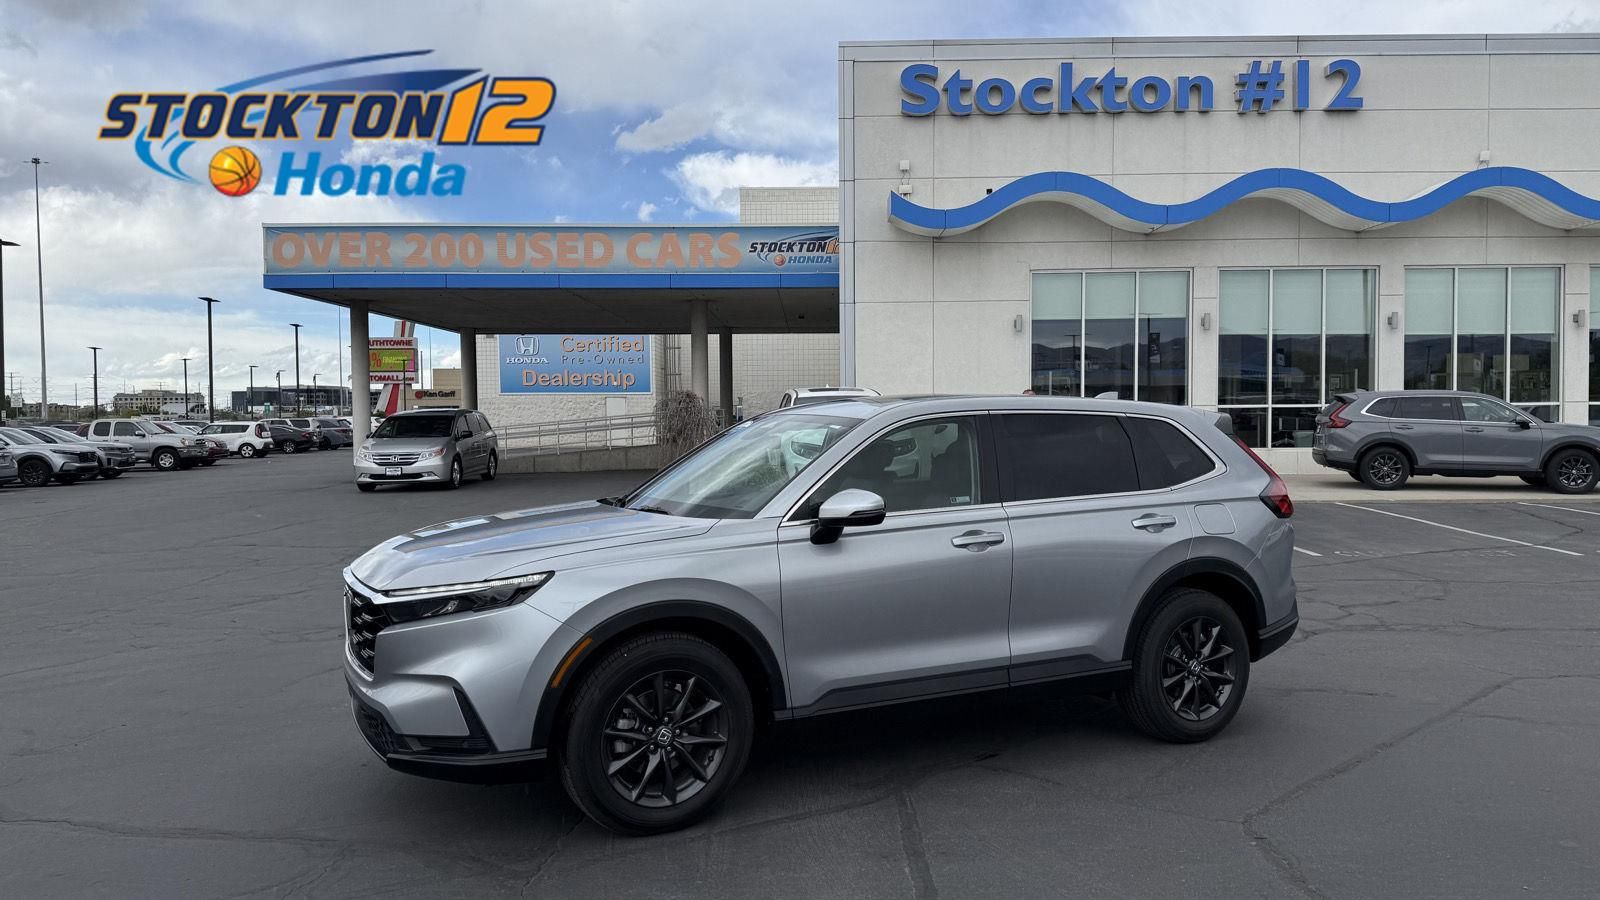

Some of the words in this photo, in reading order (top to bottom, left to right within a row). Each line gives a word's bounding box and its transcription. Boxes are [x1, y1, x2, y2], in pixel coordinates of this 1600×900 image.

[900, 63, 1214, 117] Stockton
[272, 232, 392, 268] OVER
[404, 232, 484, 268] 200
[496, 232, 614, 268] USED
[626, 232, 743, 269] CARS
[788, 255, 832, 264] HONDA
[560, 336, 645, 353] Certified
[561, 354, 645, 365] Pre-Owned
[522, 368, 635, 389] Dealership
